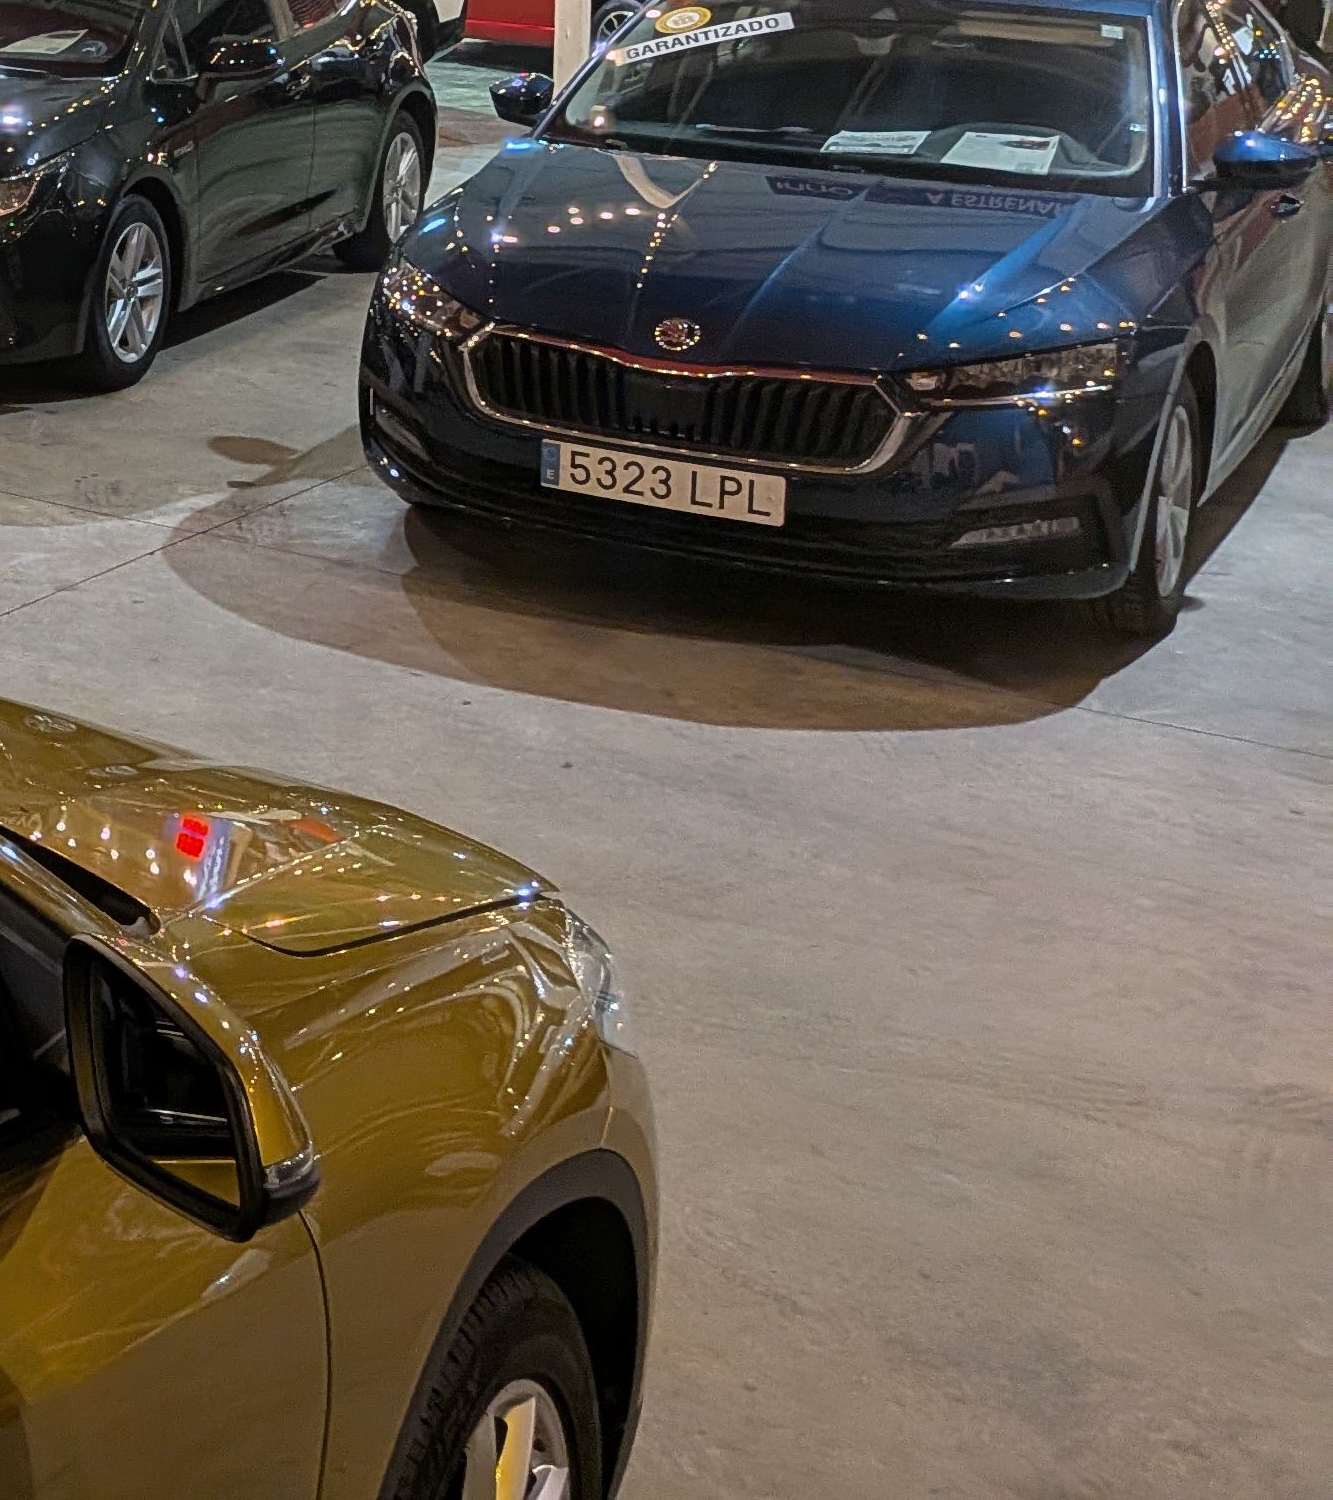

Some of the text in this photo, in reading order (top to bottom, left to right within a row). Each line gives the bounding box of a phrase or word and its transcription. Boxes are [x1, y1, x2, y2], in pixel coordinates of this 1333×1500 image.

[625, 15, 781, 61] GARANTIZADO
[546, 450, 771, 518] E 5323 LPL
